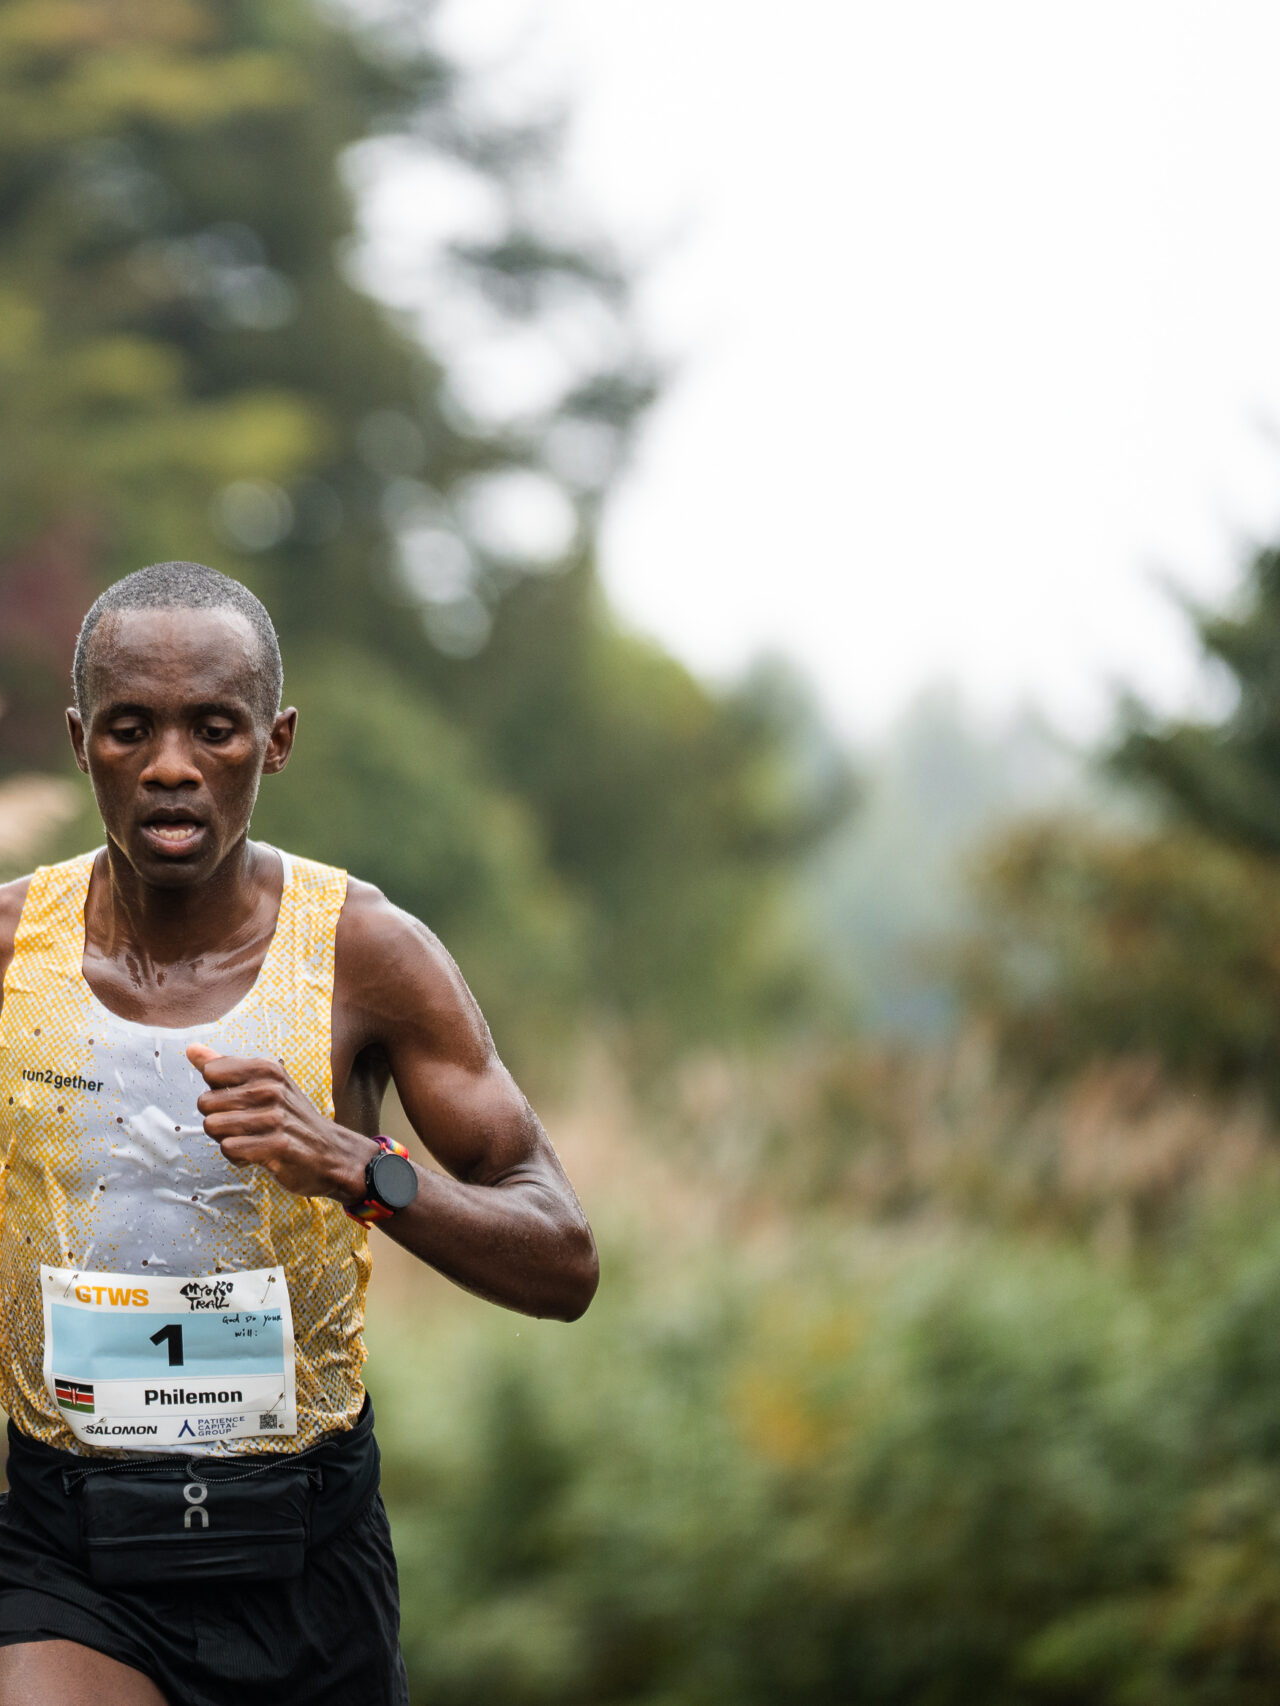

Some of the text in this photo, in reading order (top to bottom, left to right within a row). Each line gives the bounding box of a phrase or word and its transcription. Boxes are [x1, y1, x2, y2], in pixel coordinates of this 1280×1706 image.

[22, 1068, 104, 1093] run2gether
[75, 1285, 150, 1307] GTWS
[185, 1296, 230, 1311] TRAIL
[222, 1313, 240, 1324] God
[149, 1324, 184, 1366] 1
[144, 1388, 243, 1406] Philemon
[197, 1416, 245, 1425] PATIENCE
[197, 1422, 238, 1431] CAPITAL
[85, 1425, 158, 1435] SALOMON
[197, 1428, 232, 1437] GROUP
